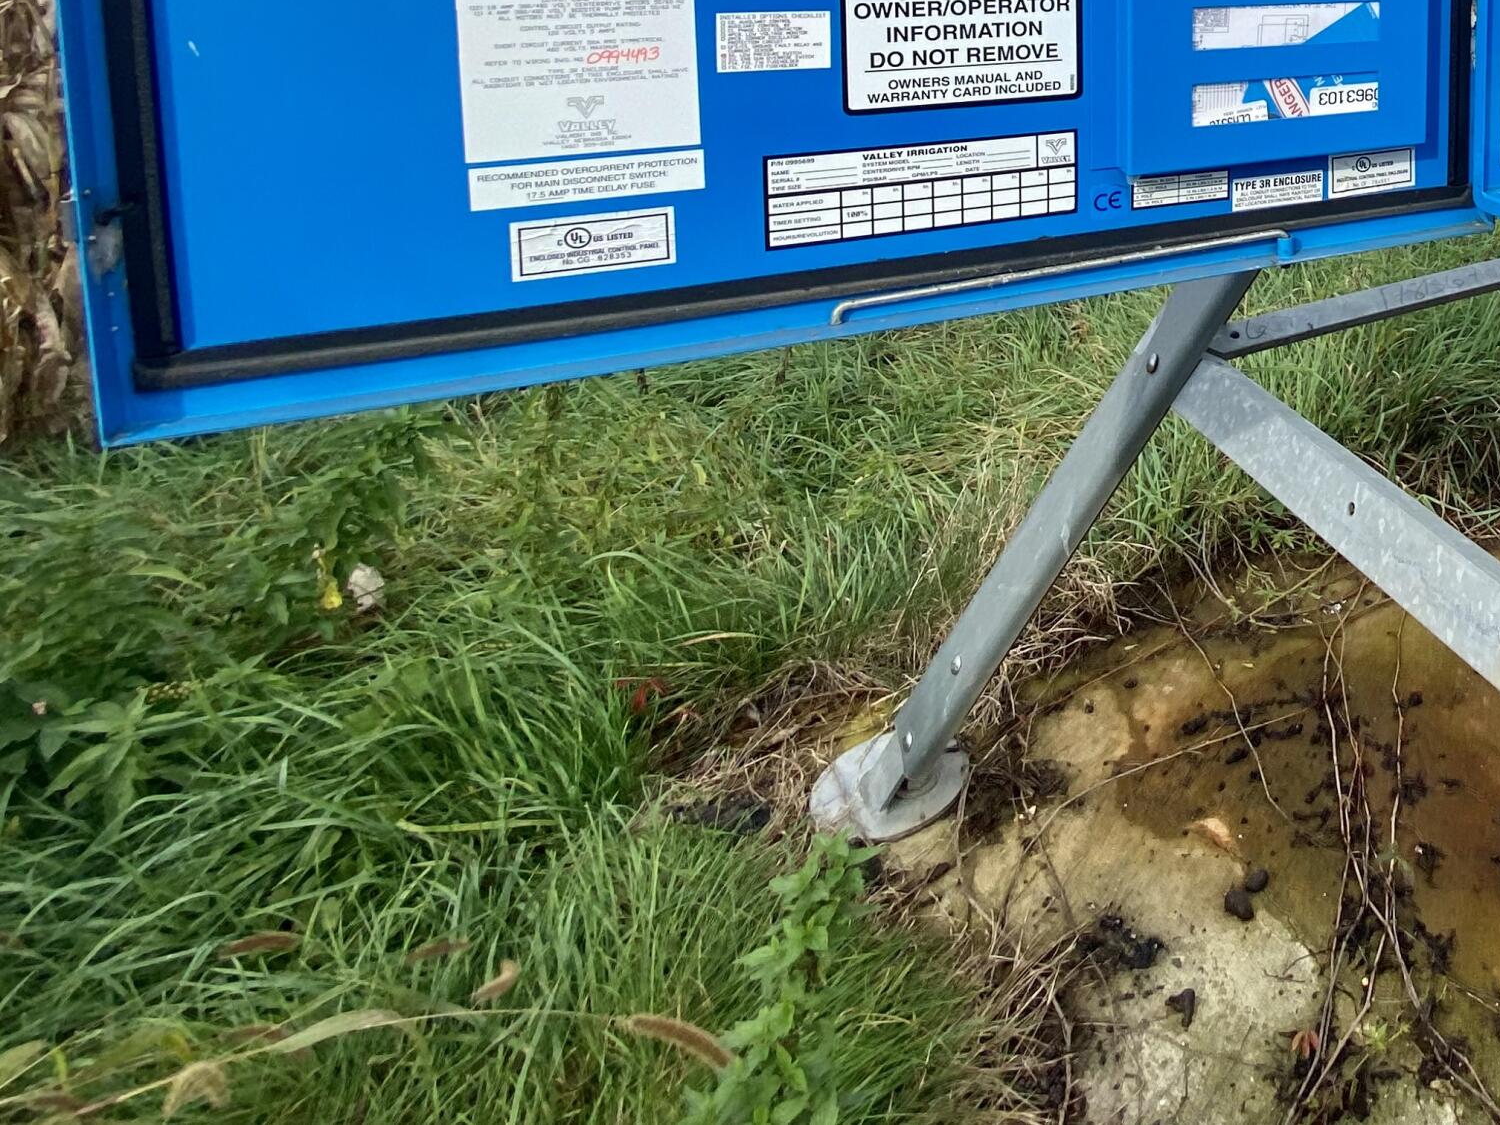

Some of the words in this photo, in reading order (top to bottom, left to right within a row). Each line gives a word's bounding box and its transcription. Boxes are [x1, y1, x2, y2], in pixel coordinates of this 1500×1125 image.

[887, 21, 1043, 43] INFORMATION
[587, 46, 660, 64] 0994493
[870, 52, 904, 68] DO
[913, 49, 959, 66] NOT
[967, 43, 1058, 62] REMOVE
[888, 77, 950, 89] OWNERS
[955, 73, 1011, 85] MANUAL
[1015, 71, 1043, 81] AND
[867, 89, 948, 104] WARRANTY
[953, 86, 991, 97] CARD
[996, 81, 1061, 94] INCLUDED
[558, 119, 617, 133] VALLEY
[863, 151, 903, 161] VALLEY
[907, 145, 968, 157] IRRIGATION
[477, 168, 558, 182] RECOMMENDED
[561, 163, 635, 176] OVERCURRENT
[638, 158, 698, 171] PROTECTION
[862, 160, 887, 168] SYSTEM
[511, 182, 533, 190] FOR
[535, 179, 560, 188] MAIN
[563, 173, 626, 186] DISCONNECT
[629, 170, 669, 180] SWITCH:
[1235, 181, 1256, 191] TYPE
[1259, 179, 1270, 188] 3R
[1274, 173, 1322, 187] ENCLOSURE
[527, 191, 545, 199] 17.5
[549, 189, 570, 197] AMP
[573, 186, 595, 195] TIME
[598, 184, 628, 193] DELAY
[631, 181, 655, 190] FUSE
[773, 201, 794, 209] WATER
[796, 199, 823, 207] APPLIED
[1094, 191, 1122, 211] CE
[607, 232, 633, 241] LISTED
